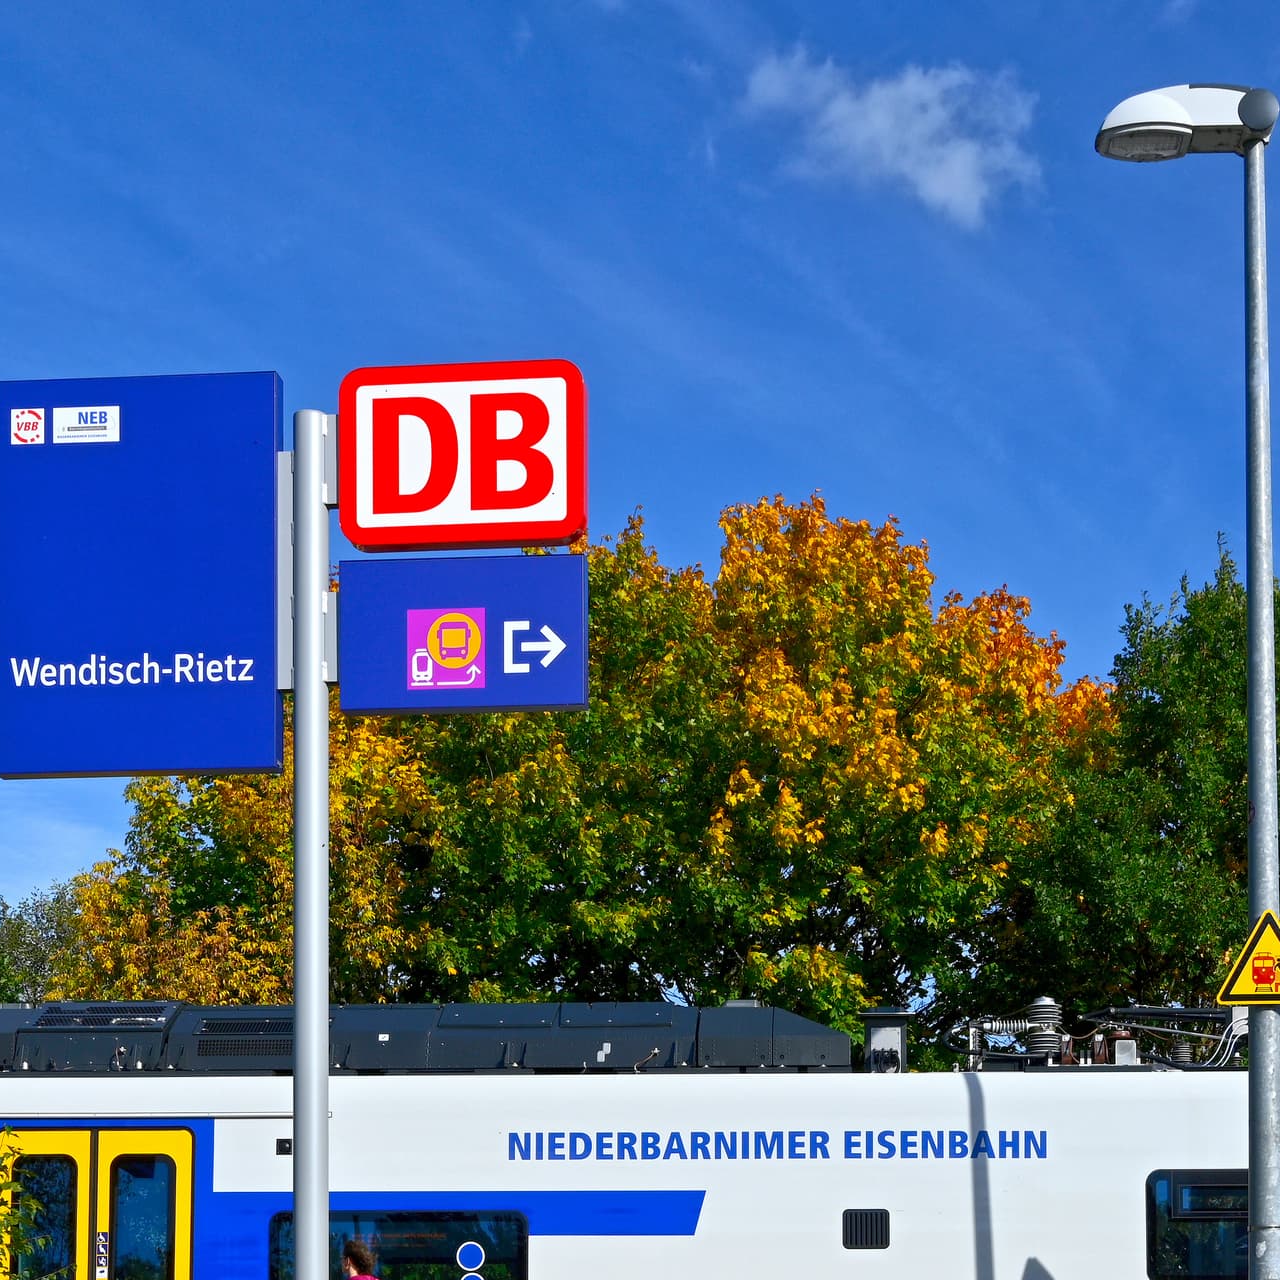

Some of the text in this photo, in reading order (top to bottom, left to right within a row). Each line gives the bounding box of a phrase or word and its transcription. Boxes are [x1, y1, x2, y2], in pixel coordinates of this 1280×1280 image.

[16, 421, 39, 432] VBB
[78, 411, 108, 425] NEB
[372, 392, 554, 515] DB
[10, 652, 254, 687] Wendisch-Rietz
[508, 1129, 1048, 1161] NIEDERBARNIMER EISENBAHN
